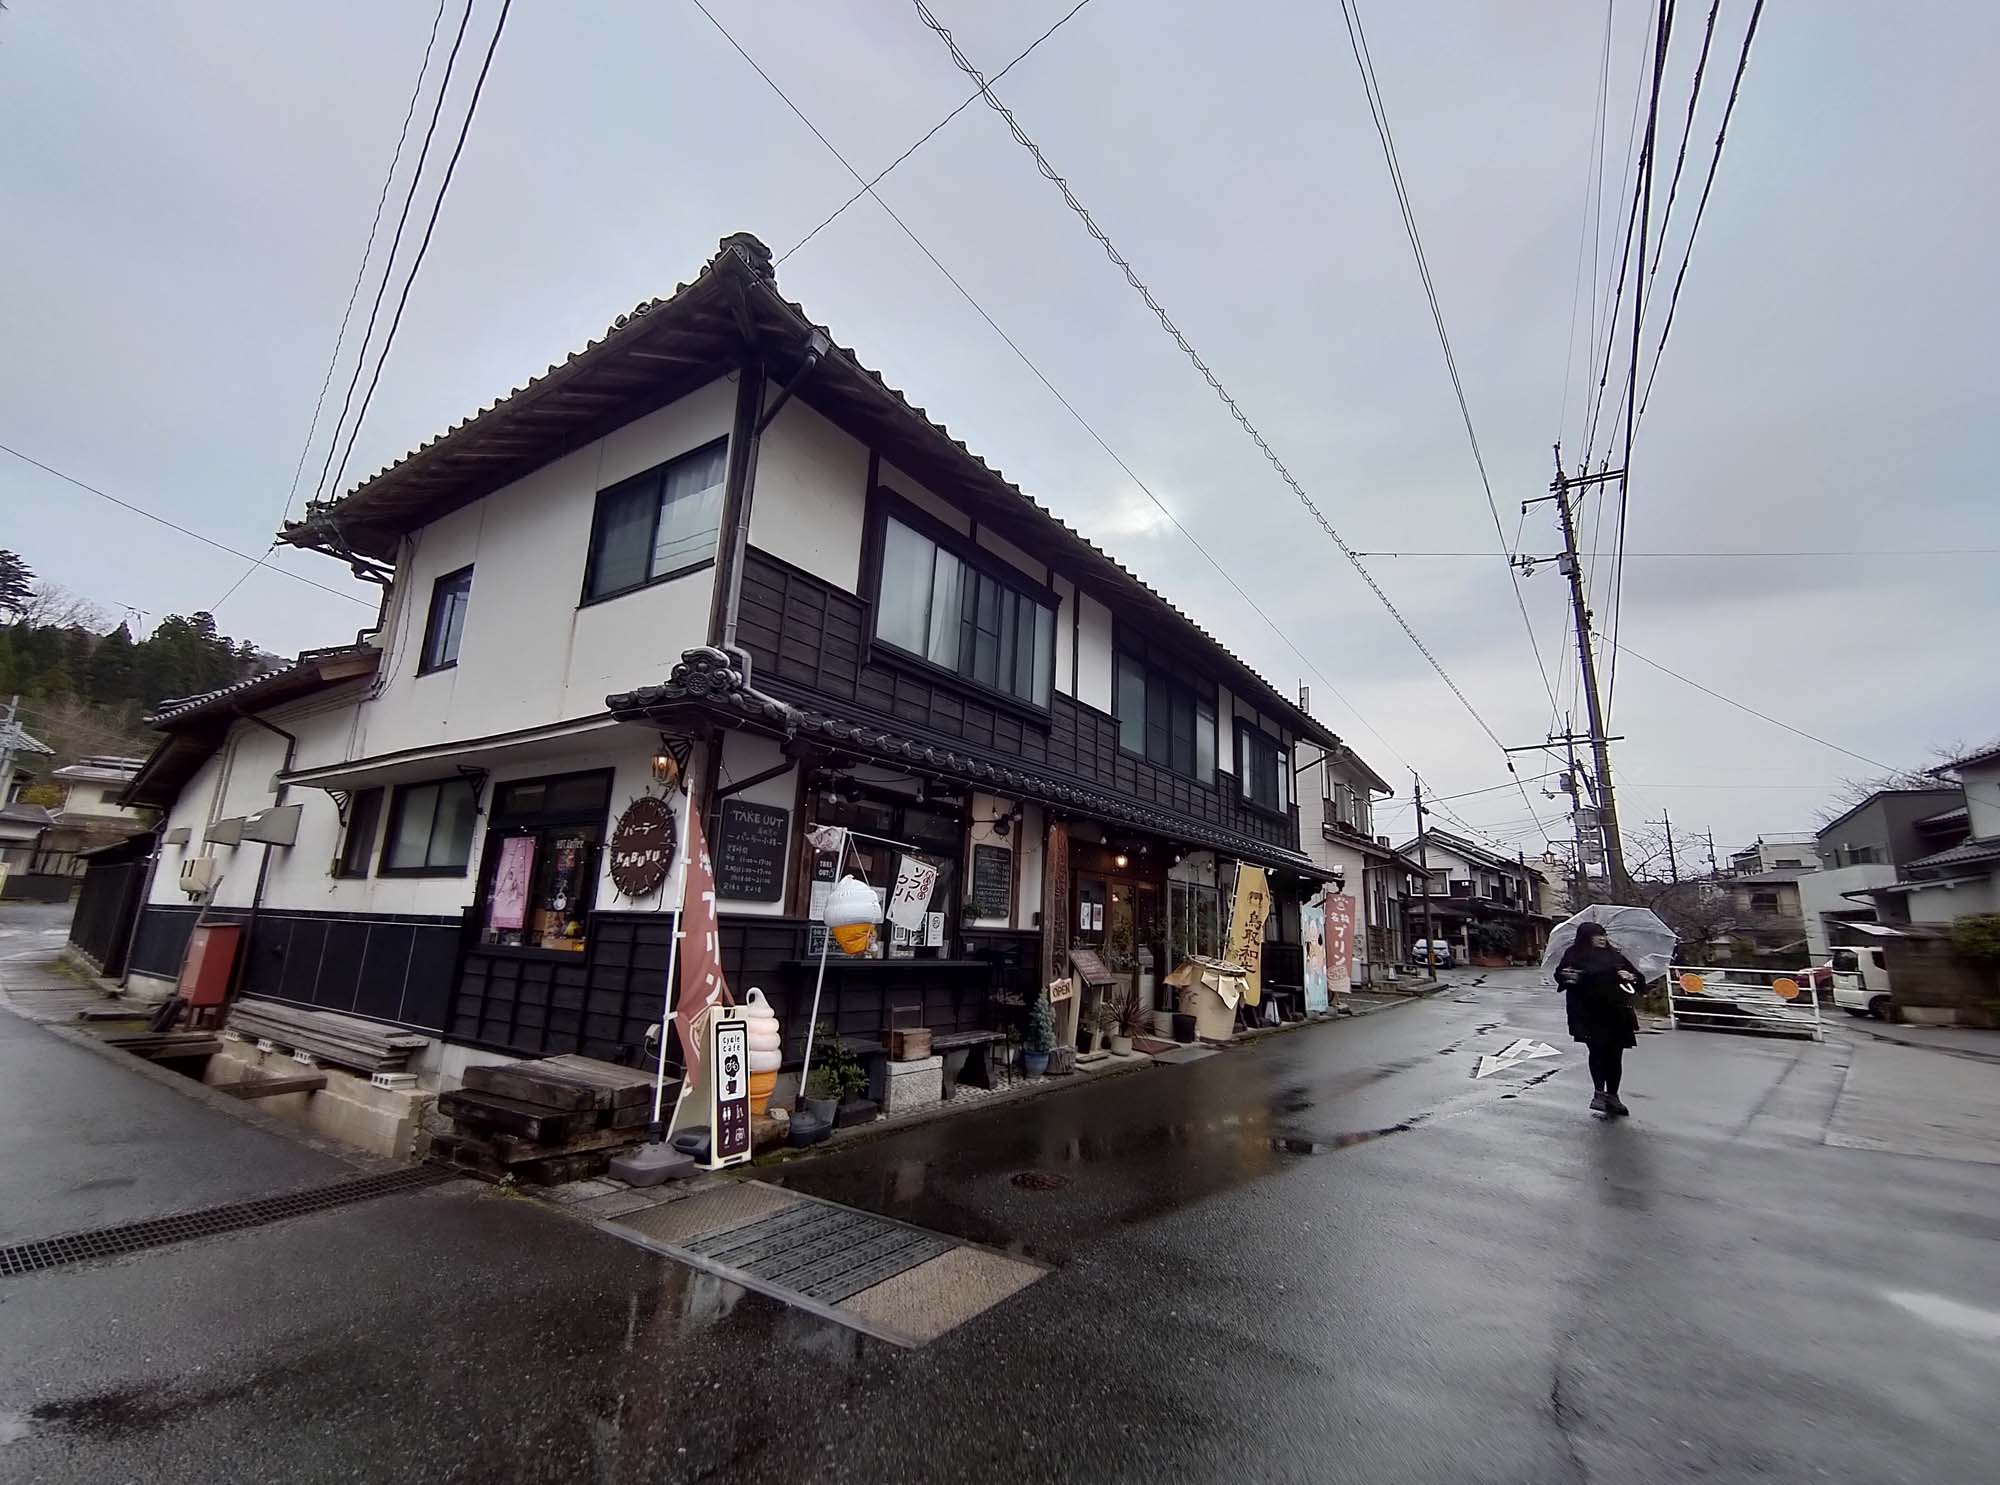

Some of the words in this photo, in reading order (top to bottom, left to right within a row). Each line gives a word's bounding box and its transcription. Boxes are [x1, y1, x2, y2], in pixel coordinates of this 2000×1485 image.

[732, 810, 760, 824] TAKE
[763, 815, 784, 828] OUT
[623, 822, 658, 837] パーラー
[556, 839, 567, 849] HOT
[615, 849, 661, 868] KABUYU
[818, 869, 829, 877] OUT
[904, 867, 925, 903] ソフト
[1334, 924, 1347, 966] プリン
[1052, 983, 1071, 999] OPEN
